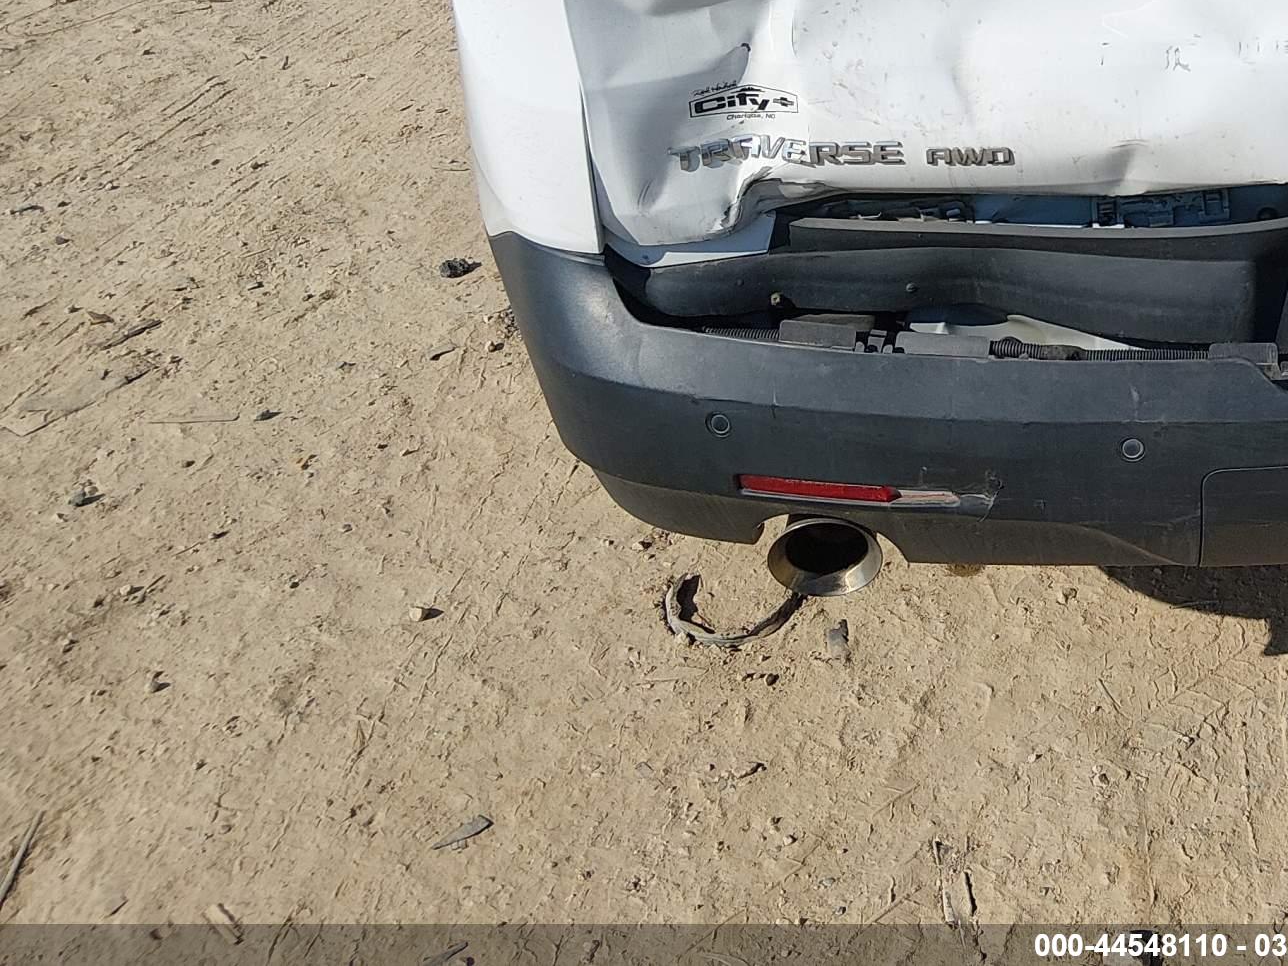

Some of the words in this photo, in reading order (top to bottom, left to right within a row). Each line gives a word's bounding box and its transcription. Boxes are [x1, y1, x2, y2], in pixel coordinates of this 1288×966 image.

[694, 93, 770, 114] City
[667, 134, 906, 172] TRAVERSE
[926, 147, 1015, 166] AWD
